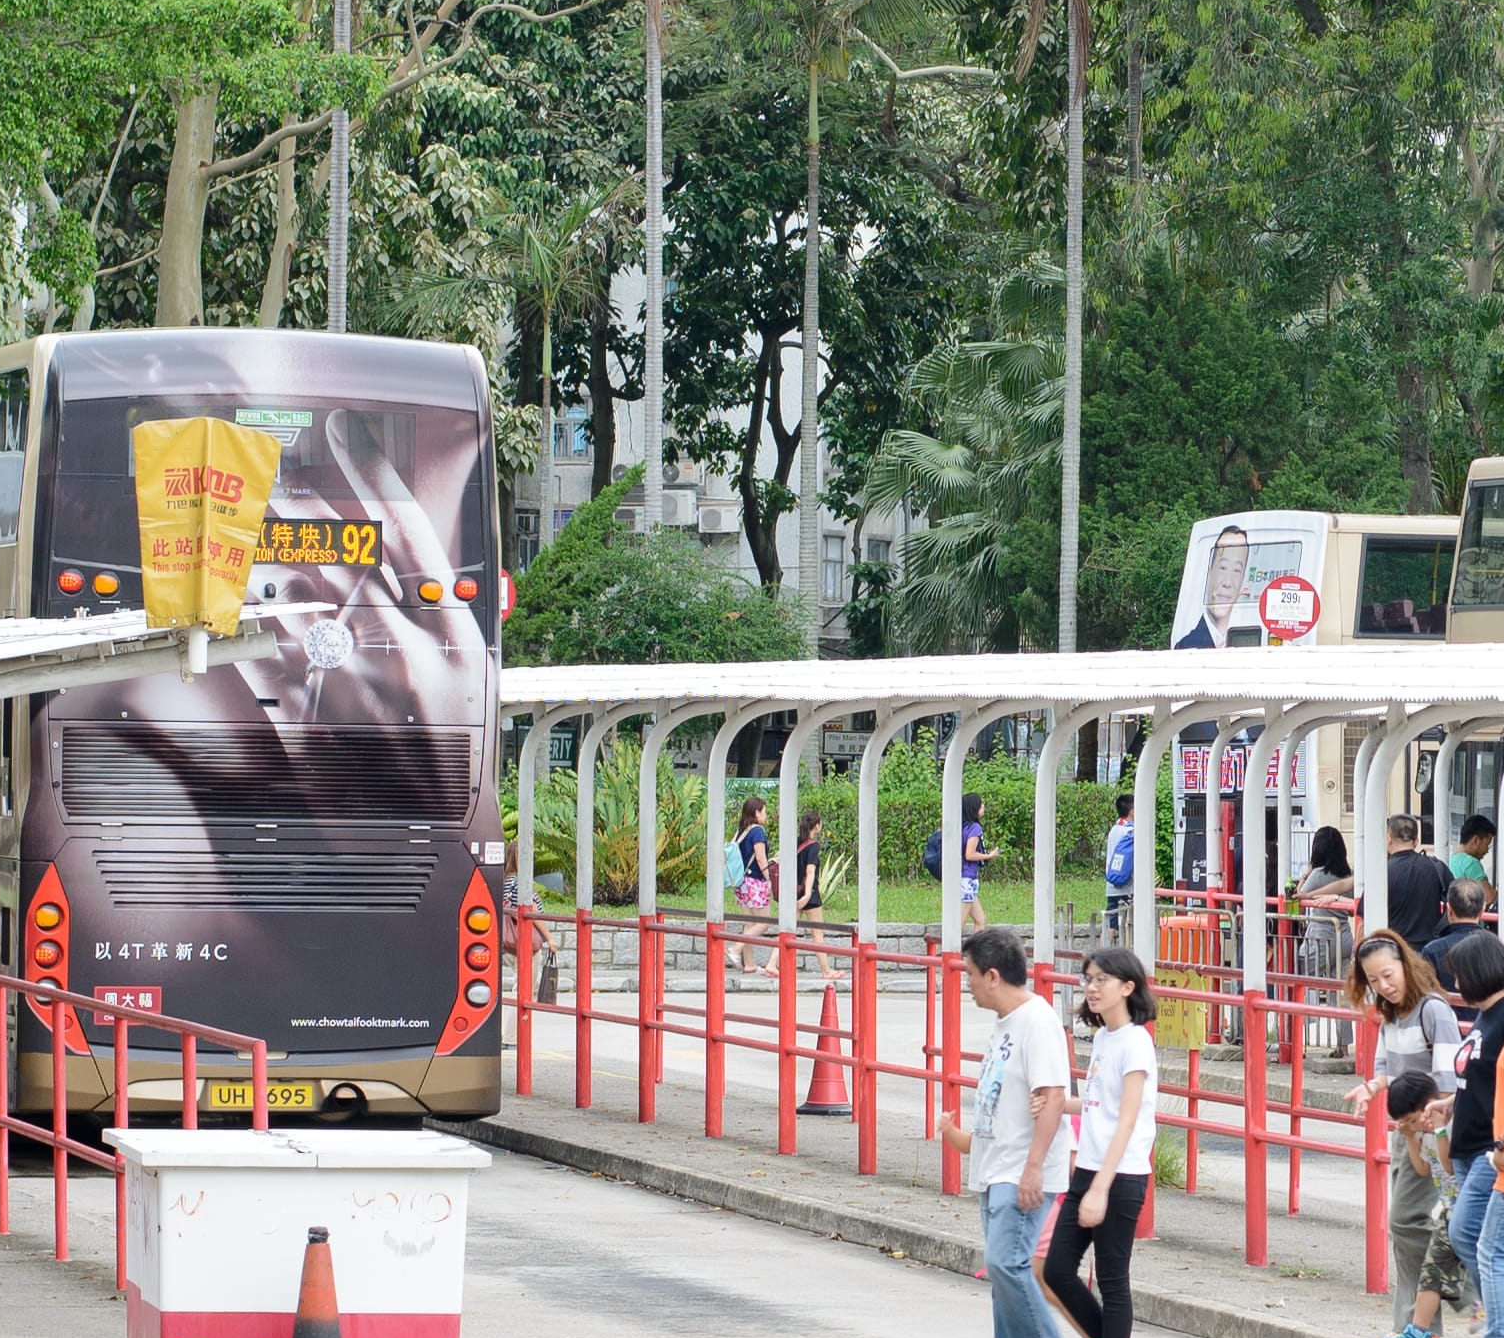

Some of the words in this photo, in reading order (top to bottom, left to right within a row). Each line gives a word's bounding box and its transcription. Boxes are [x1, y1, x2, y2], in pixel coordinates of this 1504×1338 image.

[342, 524, 377, 565] 92
[291, 1016, 429, 1029] www.chowtaifooktmark.com
[218, 1089, 245, 1104] UH
[266, 1089, 306, 1104] 695
